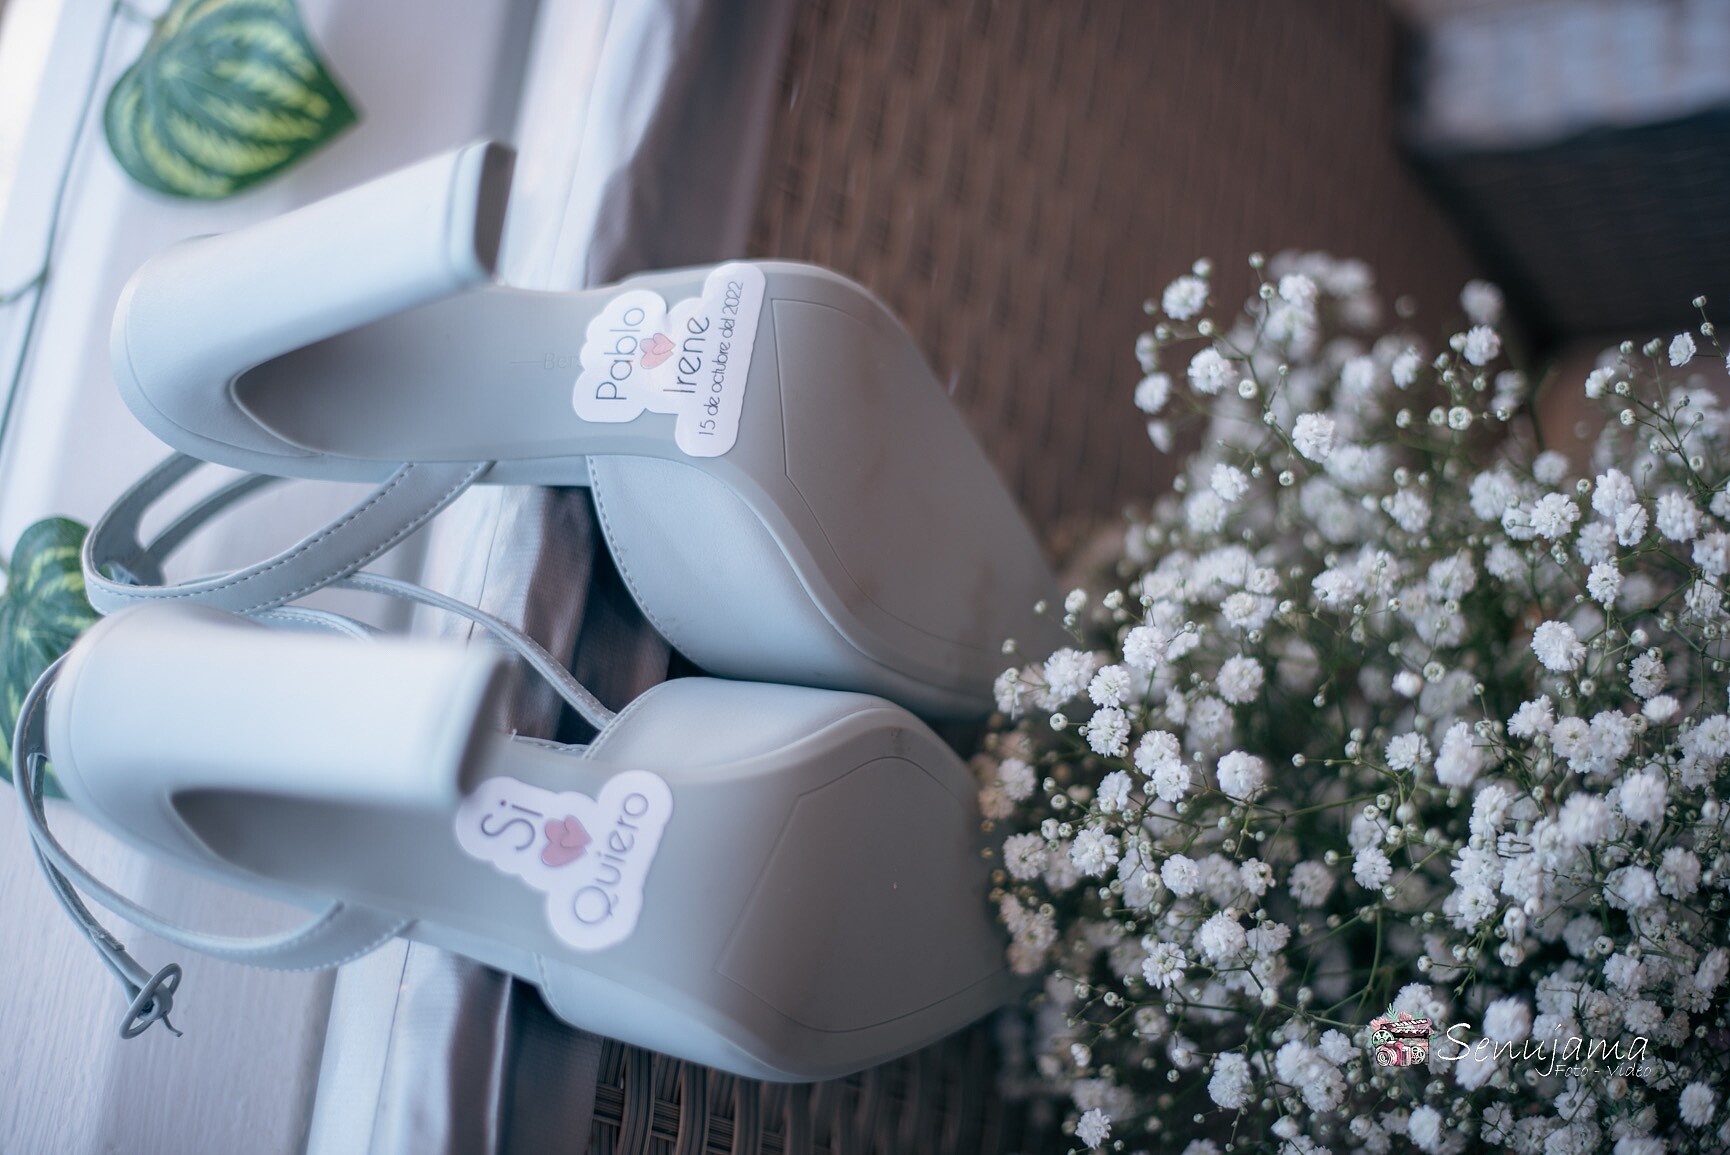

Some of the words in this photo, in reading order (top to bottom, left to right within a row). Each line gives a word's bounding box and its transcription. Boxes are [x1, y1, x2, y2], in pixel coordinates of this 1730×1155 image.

[721, 280, 744, 316] 2022
[595, 307, 645, 400] Pablo
[718, 317, 736, 339] del
[663, 316, 710, 394] Irene
[711, 341, 731, 393] octubre
[698, 419, 716, 436] 15
[703, 396, 721, 416] de
[480, 799, 544, 852] Si
[573, 792, 649, 925] Quiero
